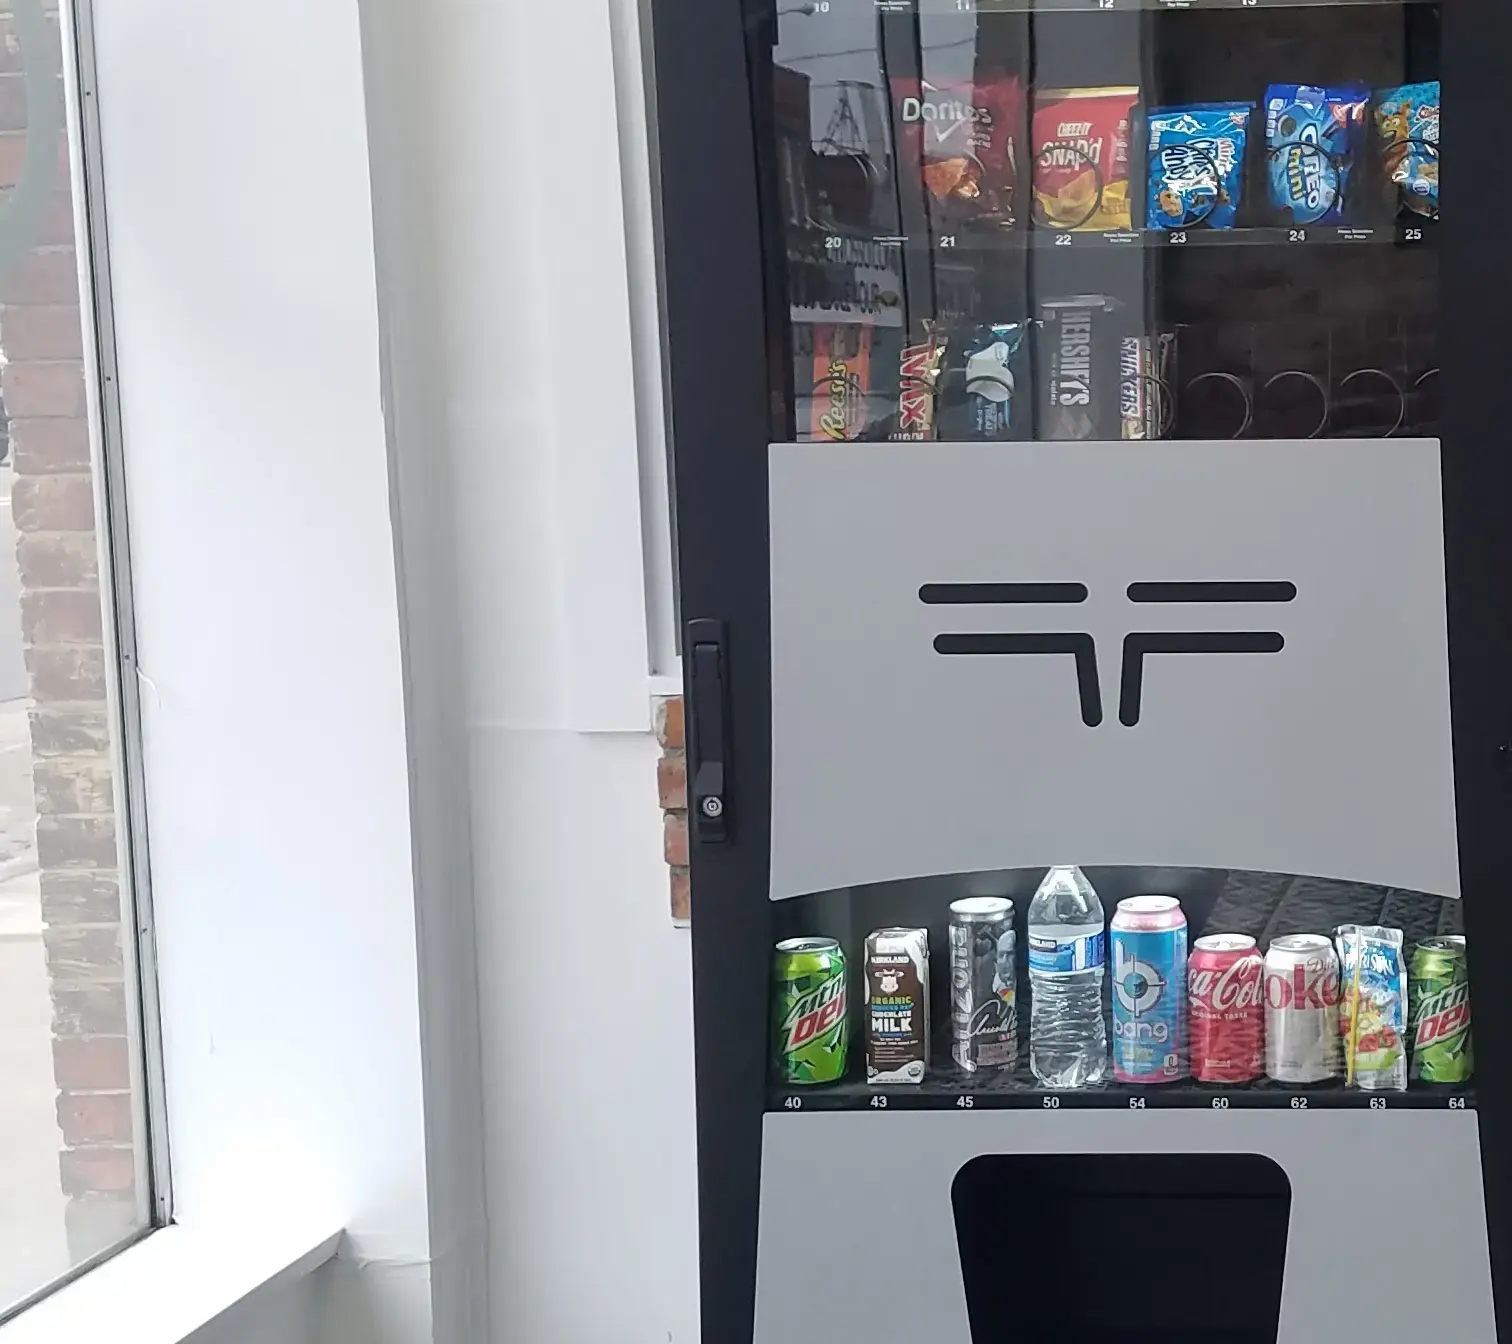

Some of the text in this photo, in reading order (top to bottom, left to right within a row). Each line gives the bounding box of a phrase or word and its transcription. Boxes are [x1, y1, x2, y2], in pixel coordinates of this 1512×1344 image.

[812, 1, 829, 13] 10
[1299, 123, 1321, 209] OREO
[1055, 234, 1072, 246] 22
[1170, 231, 1187, 244] 23
[1289, 230, 1306, 242] 24
[1405, 228, 1422, 240] 25
[826, 236, 842, 248] 20
[940, 236, 956, 247] 21
[871, 996, 912, 1004] ORGANIC
[871, 1017, 913, 1033] MILK
[784, 1096, 802, 1109] 40
[870, 1096, 888, 1108] 43
[956, 1096, 974, 1108] 45
[1043, 1096, 1060, 1108] 50
[1129, 1097, 1146, 1109] 54
[1212, 1097, 1229, 1109] 60
[1290, 1097, 1308, 1109] 62
[1370, 1097, 1387, 1109] 63
[1449, 1097, 1466, 1109] 64
